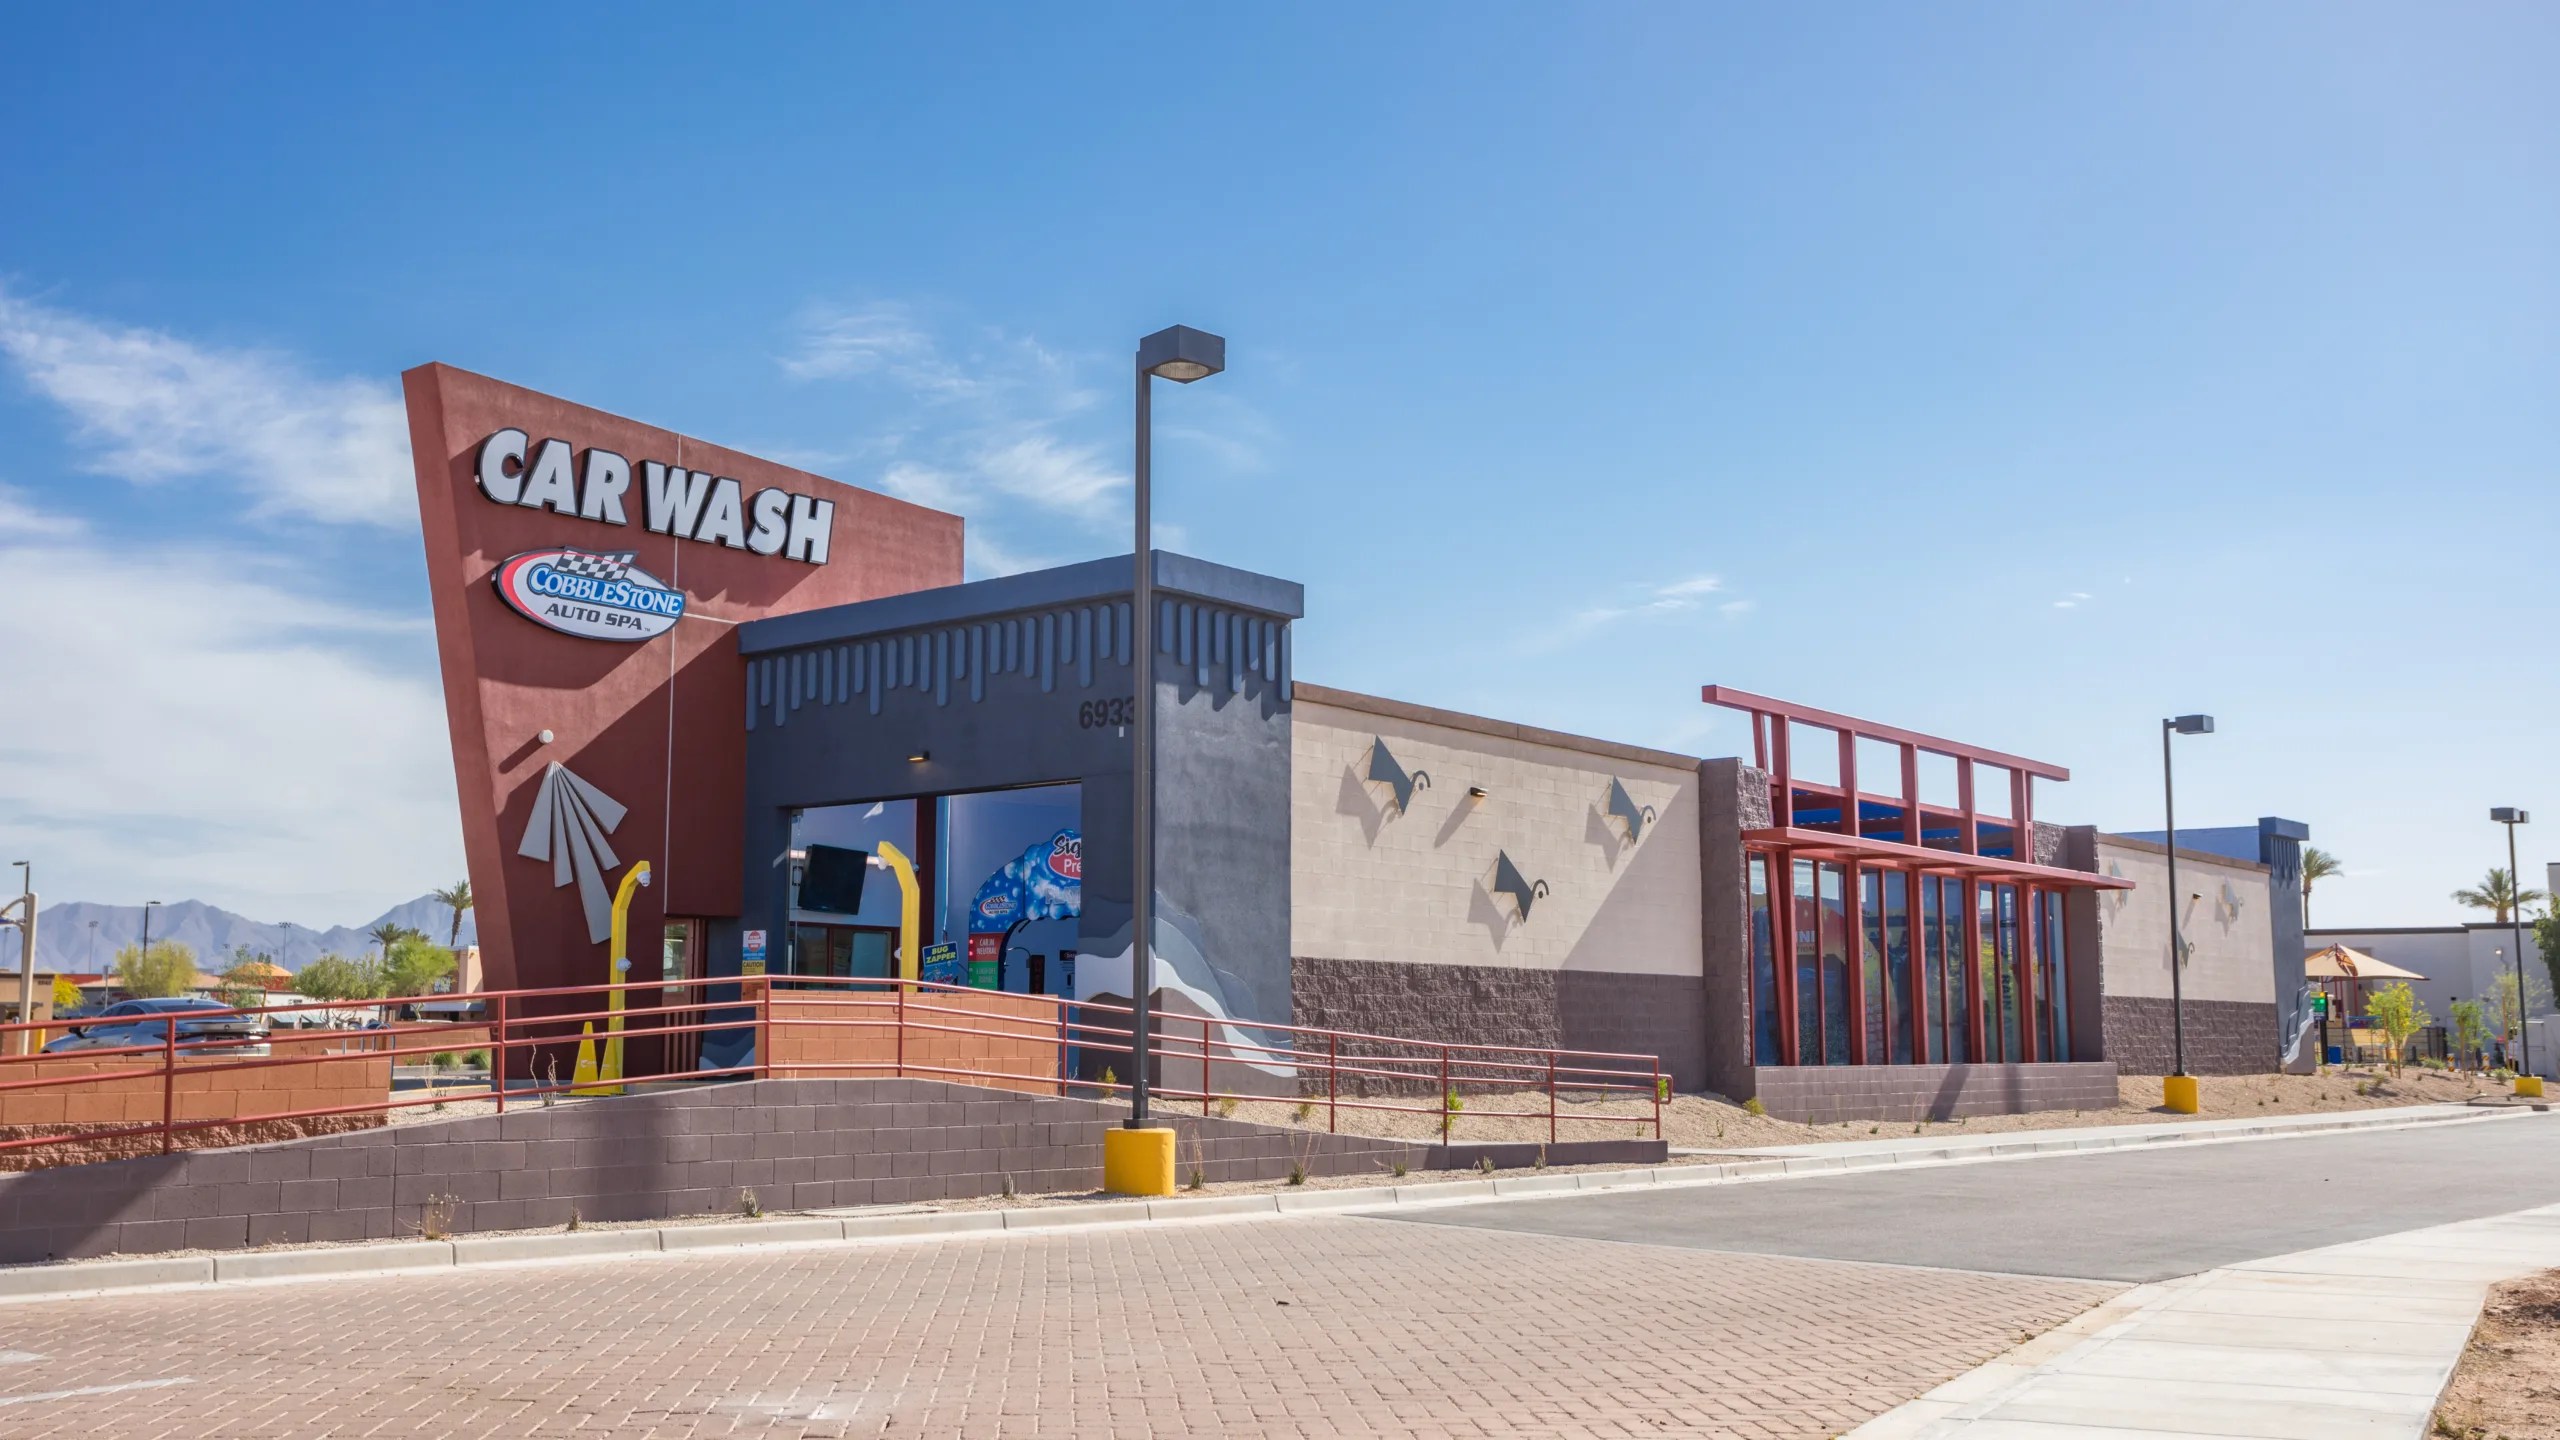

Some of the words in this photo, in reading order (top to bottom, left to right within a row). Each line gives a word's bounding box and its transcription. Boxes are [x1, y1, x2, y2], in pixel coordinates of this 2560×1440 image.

[476, 427, 631, 526] CAR
[640, 459, 835, 565] WASH
[530, 566, 683, 615] COBBLESTONE
[544, 603, 600, 623] AUTO
[604, 612, 642, 631] SPA
[1079, 695, 1135, 730] 6933
[925, 951, 956, 964] ZAPPER
[931, 945, 949, 955] BUG
